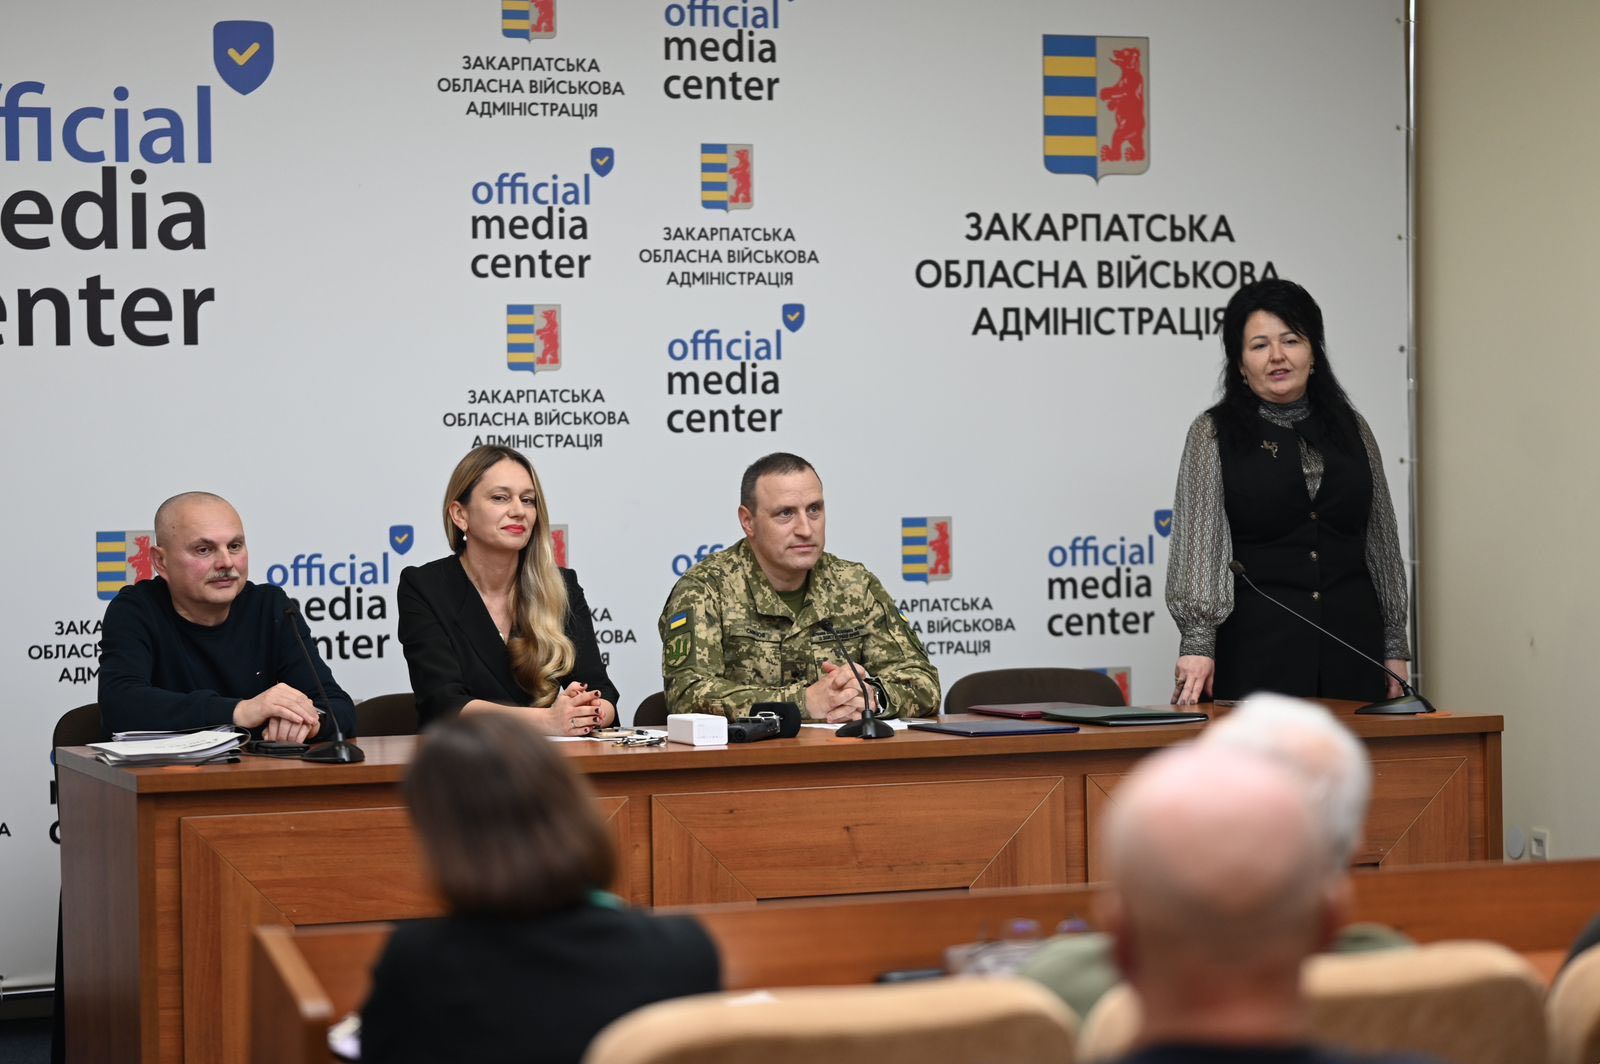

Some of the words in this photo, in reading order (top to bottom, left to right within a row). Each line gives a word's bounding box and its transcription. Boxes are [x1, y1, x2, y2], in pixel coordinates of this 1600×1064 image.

[664, 0, 779, 29] official
[664, 27, 778, 63] media
[462, 56, 600, 74] ЗАКАРПАТСЬКА
[438, 78, 524, 96] ОБЛАСНА
[529, 77, 625, 96] ВІЙСЬКОВА
[664, 72, 779, 101] center
[0, 81, 212, 164] ficial
[466, 101, 598, 119] АДМІНІСТРАЦІЯ
[472, 172, 591, 206] official
[0, 166, 206, 251] edia
[472, 206, 589, 240] media
[663, 227, 796, 242] ЗАКАРПАТСЬКА
[965, 211, 1235, 243] ЗАКАРПАТСЬКА
[471, 250, 592, 279] center
[639, 249, 723, 264] ОБЛАСНА
[727, 246, 820, 264] ВІЙСЬКОВА
[666, 272, 794, 288] АДМІНІСТРАЦІЯ
[915, 259, 1088, 289] ОБЛАСНА
[1097, 255, 1279, 289] ВІЙСЬКОВА
[668, 329, 782, 360] official
[668, 362, 780, 394] media
[467, 389, 605, 405] ЗАКАРПАТСЬКА
[442, 412, 530, 427] ОБЛАСНА
[534, 408, 630, 426] ВІЙСЬКОВА
[667, 405, 783, 433] center
[471, 433, 604, 450] АДМІНІСТРАЦІЯ
[1048, 534, 1154, 567] official
[266, 552, 389, 587] official
[1048, 564, 1153, 600] media
[898, 597, 994, 613] АРПАТСЬКА
[927, 617, 1017, 634] ВІЙСЬКОВА
[1048, 607, 1155, 637] center
[28, 643, 103, 660] ОБЛАСН
[311, 630, 391, 660] nter
[925, 640, 992, 656] СТРАЦІЯ
